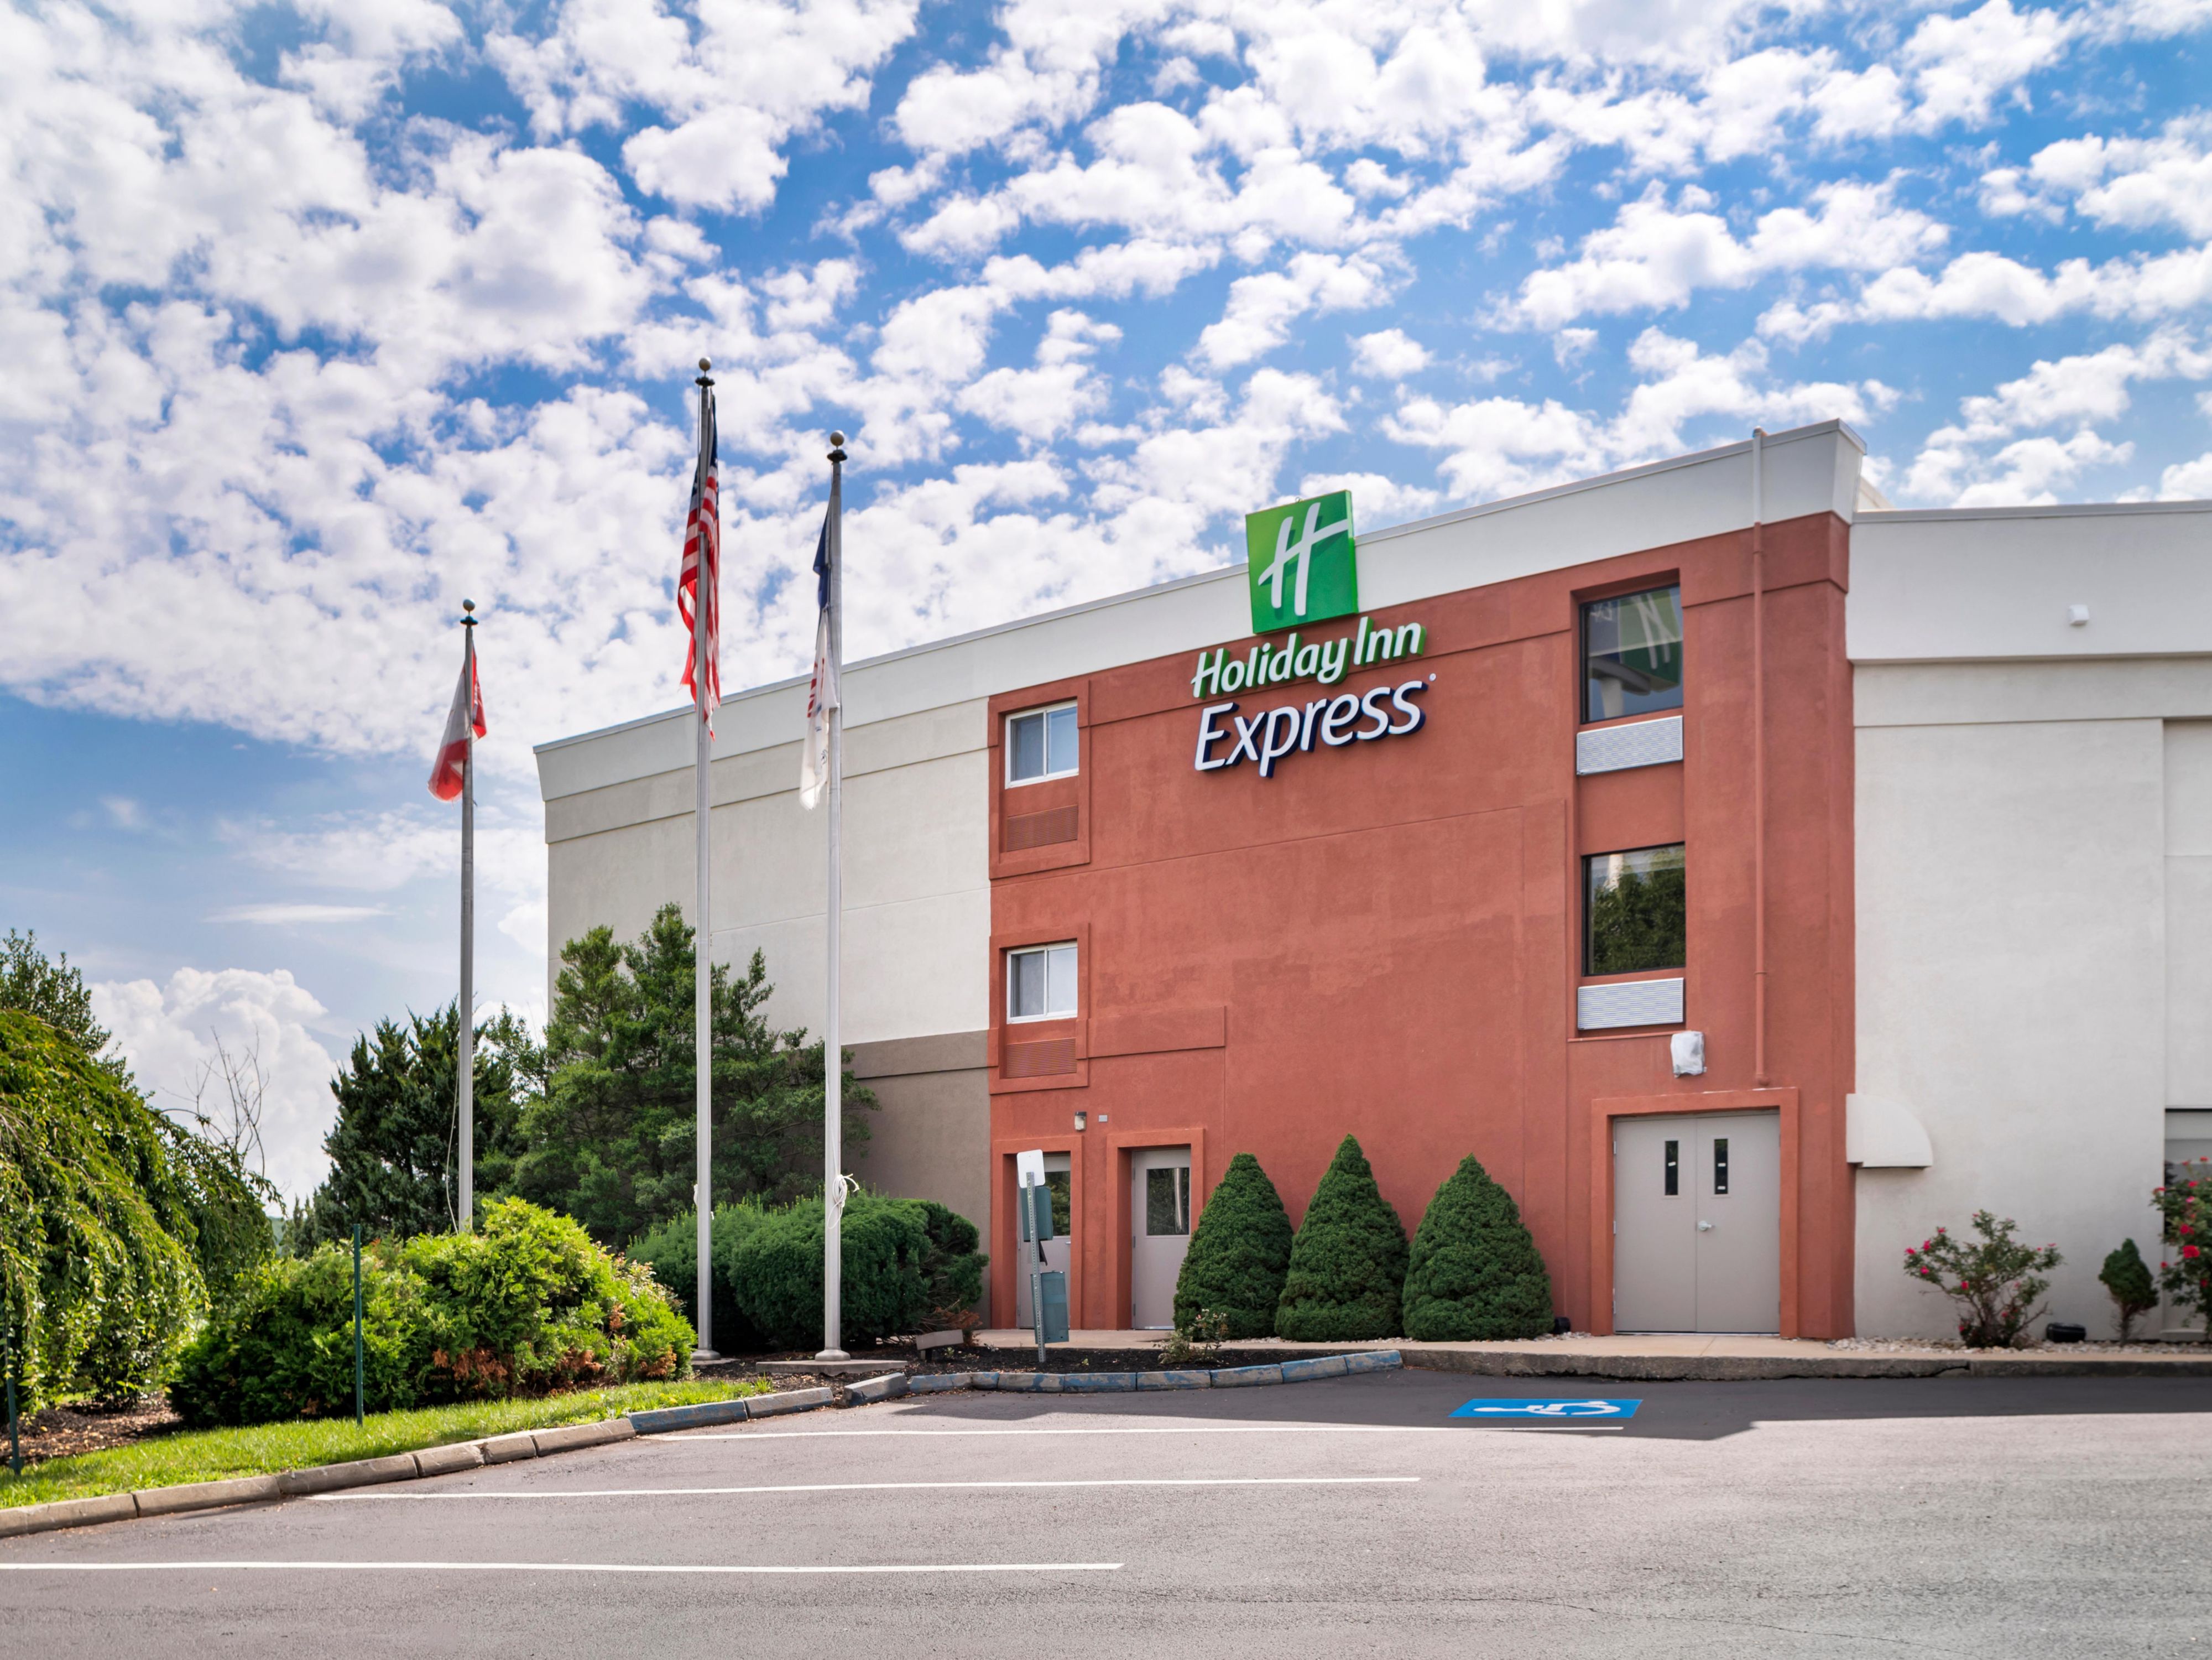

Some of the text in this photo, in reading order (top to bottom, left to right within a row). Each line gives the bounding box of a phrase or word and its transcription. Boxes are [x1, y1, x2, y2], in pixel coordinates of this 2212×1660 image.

[1258, 502, 1349, 616] H
[1191, 616, 1426, 699] Holiday Inn
[1194, 680, 1428, 778] Express
